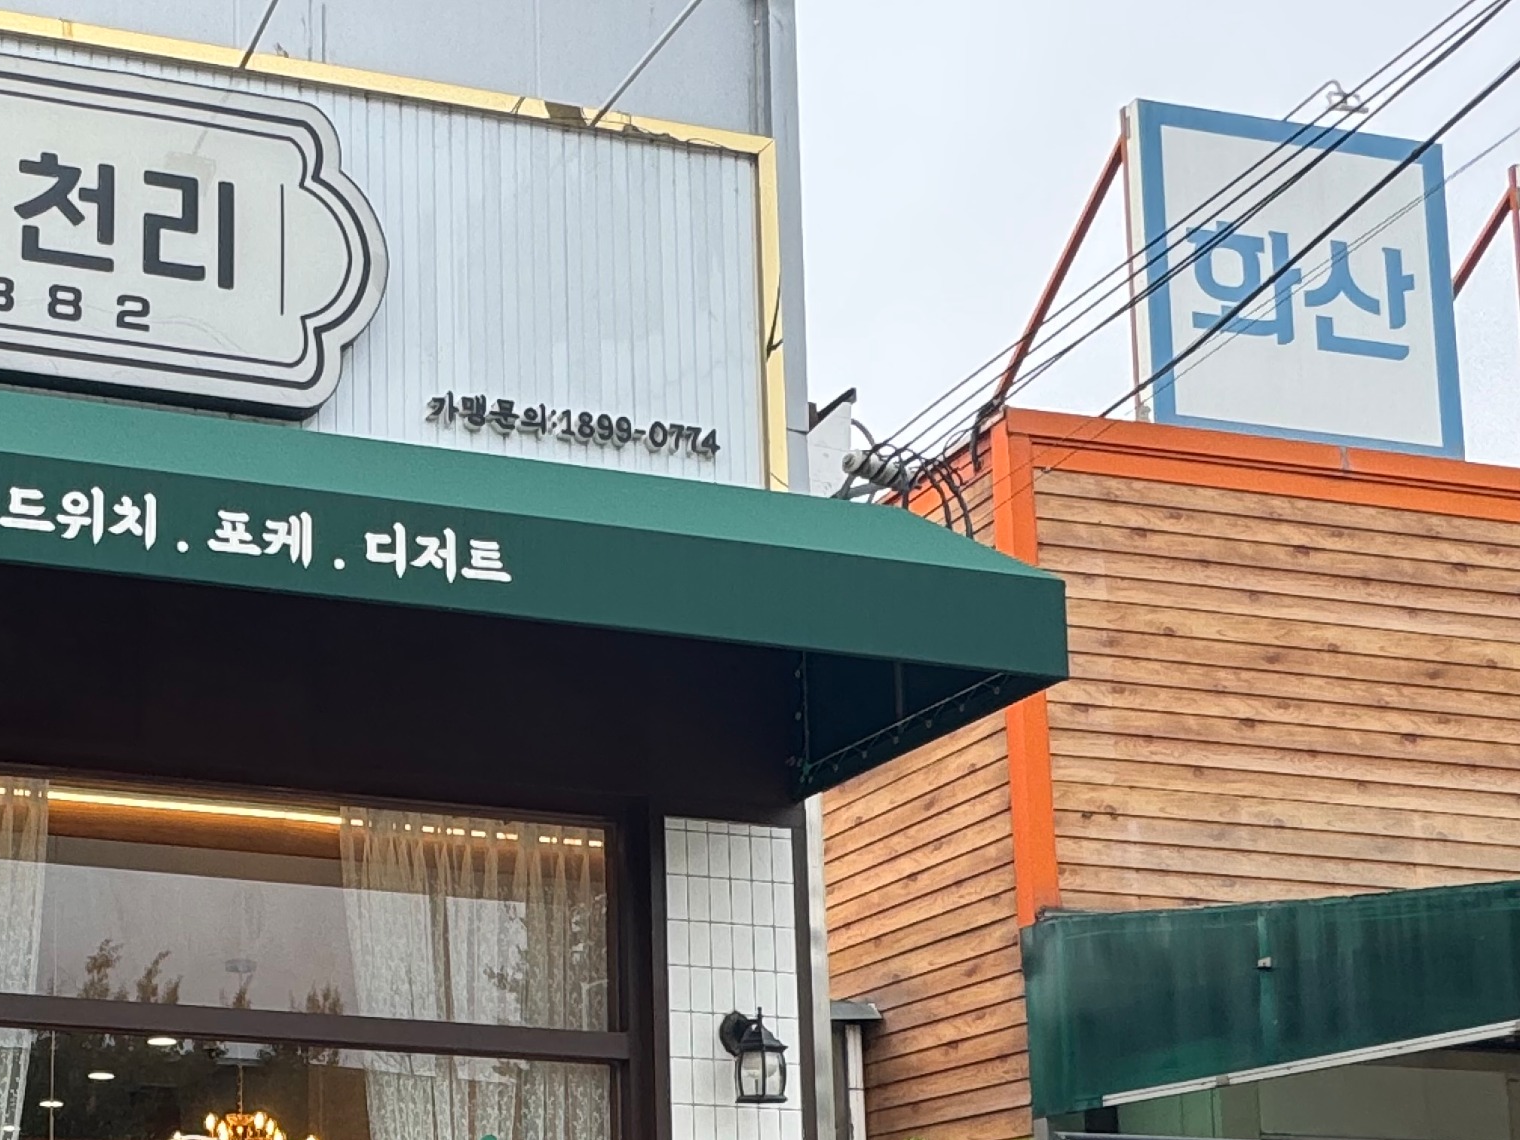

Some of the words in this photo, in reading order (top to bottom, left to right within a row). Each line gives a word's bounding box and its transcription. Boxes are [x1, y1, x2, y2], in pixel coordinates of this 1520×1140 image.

[1185, 219, 1416, 362] 화산
[206, 509, 314, 570] 포케
[364, 521, 513, 585] 디저트
